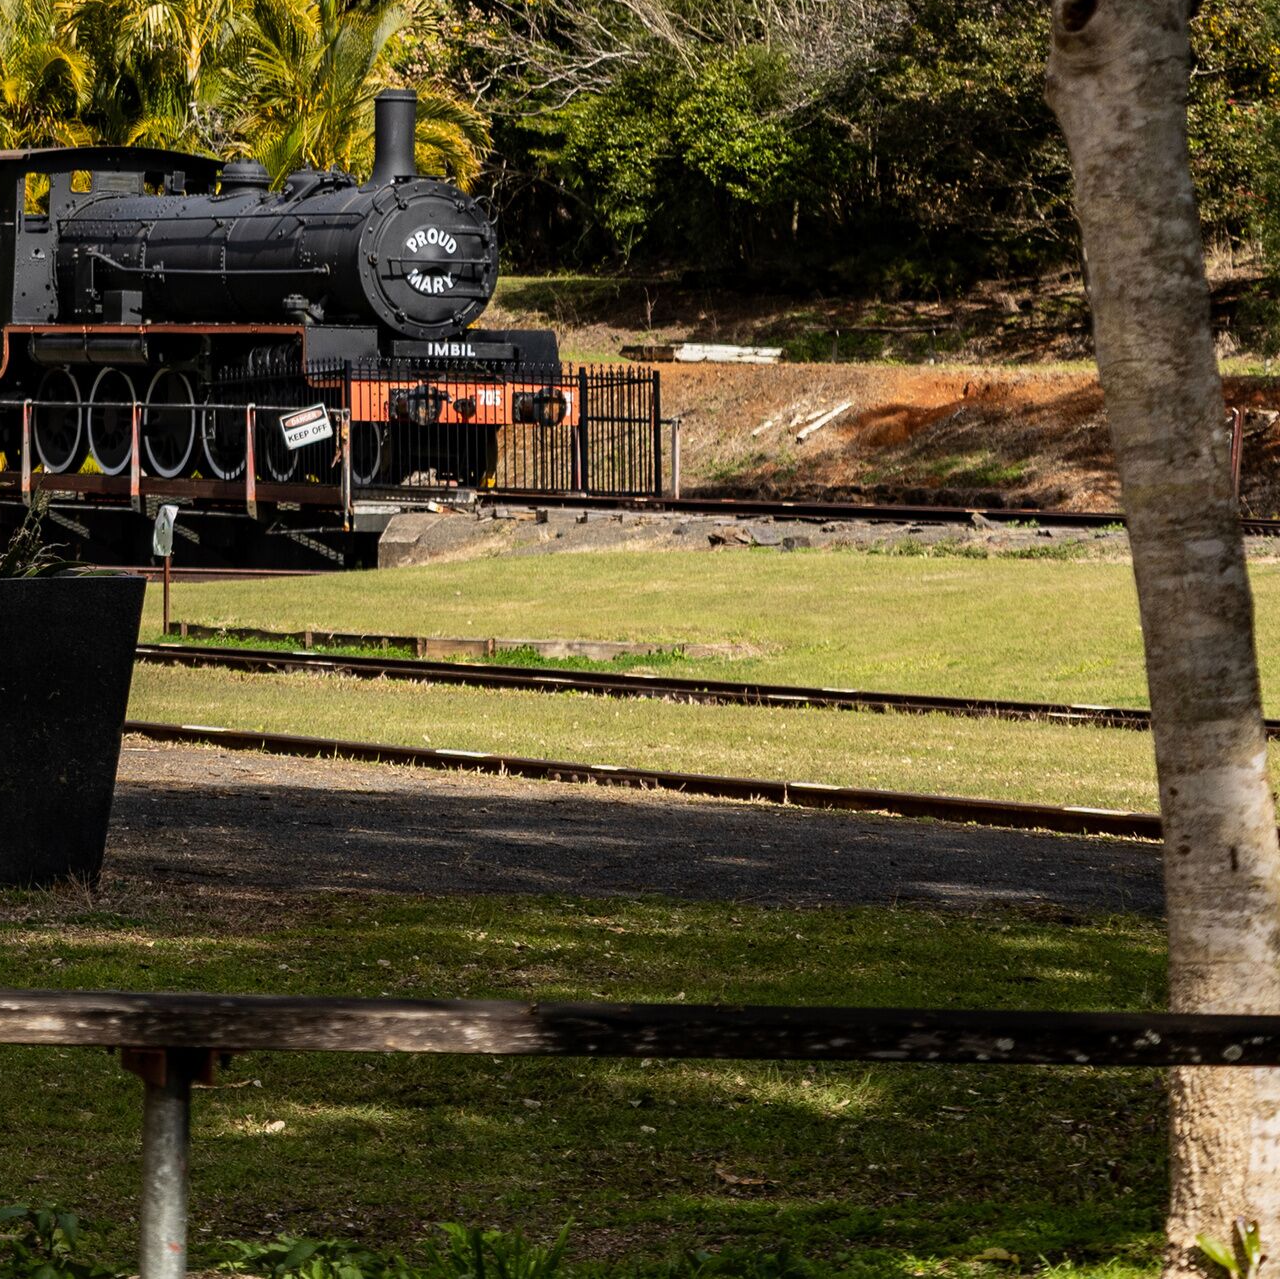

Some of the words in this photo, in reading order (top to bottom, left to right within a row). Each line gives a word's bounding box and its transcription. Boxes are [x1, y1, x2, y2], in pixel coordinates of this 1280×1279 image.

[406, 227, 457, 254] PROUD
[407, 268, 454, 293] MARY
[427, 342, 476, 357] IMBIL
[476, 389, 501, 407] 705
[287, 430, 309, 443] KEEP
[312, 424, 327, 435] OFF
